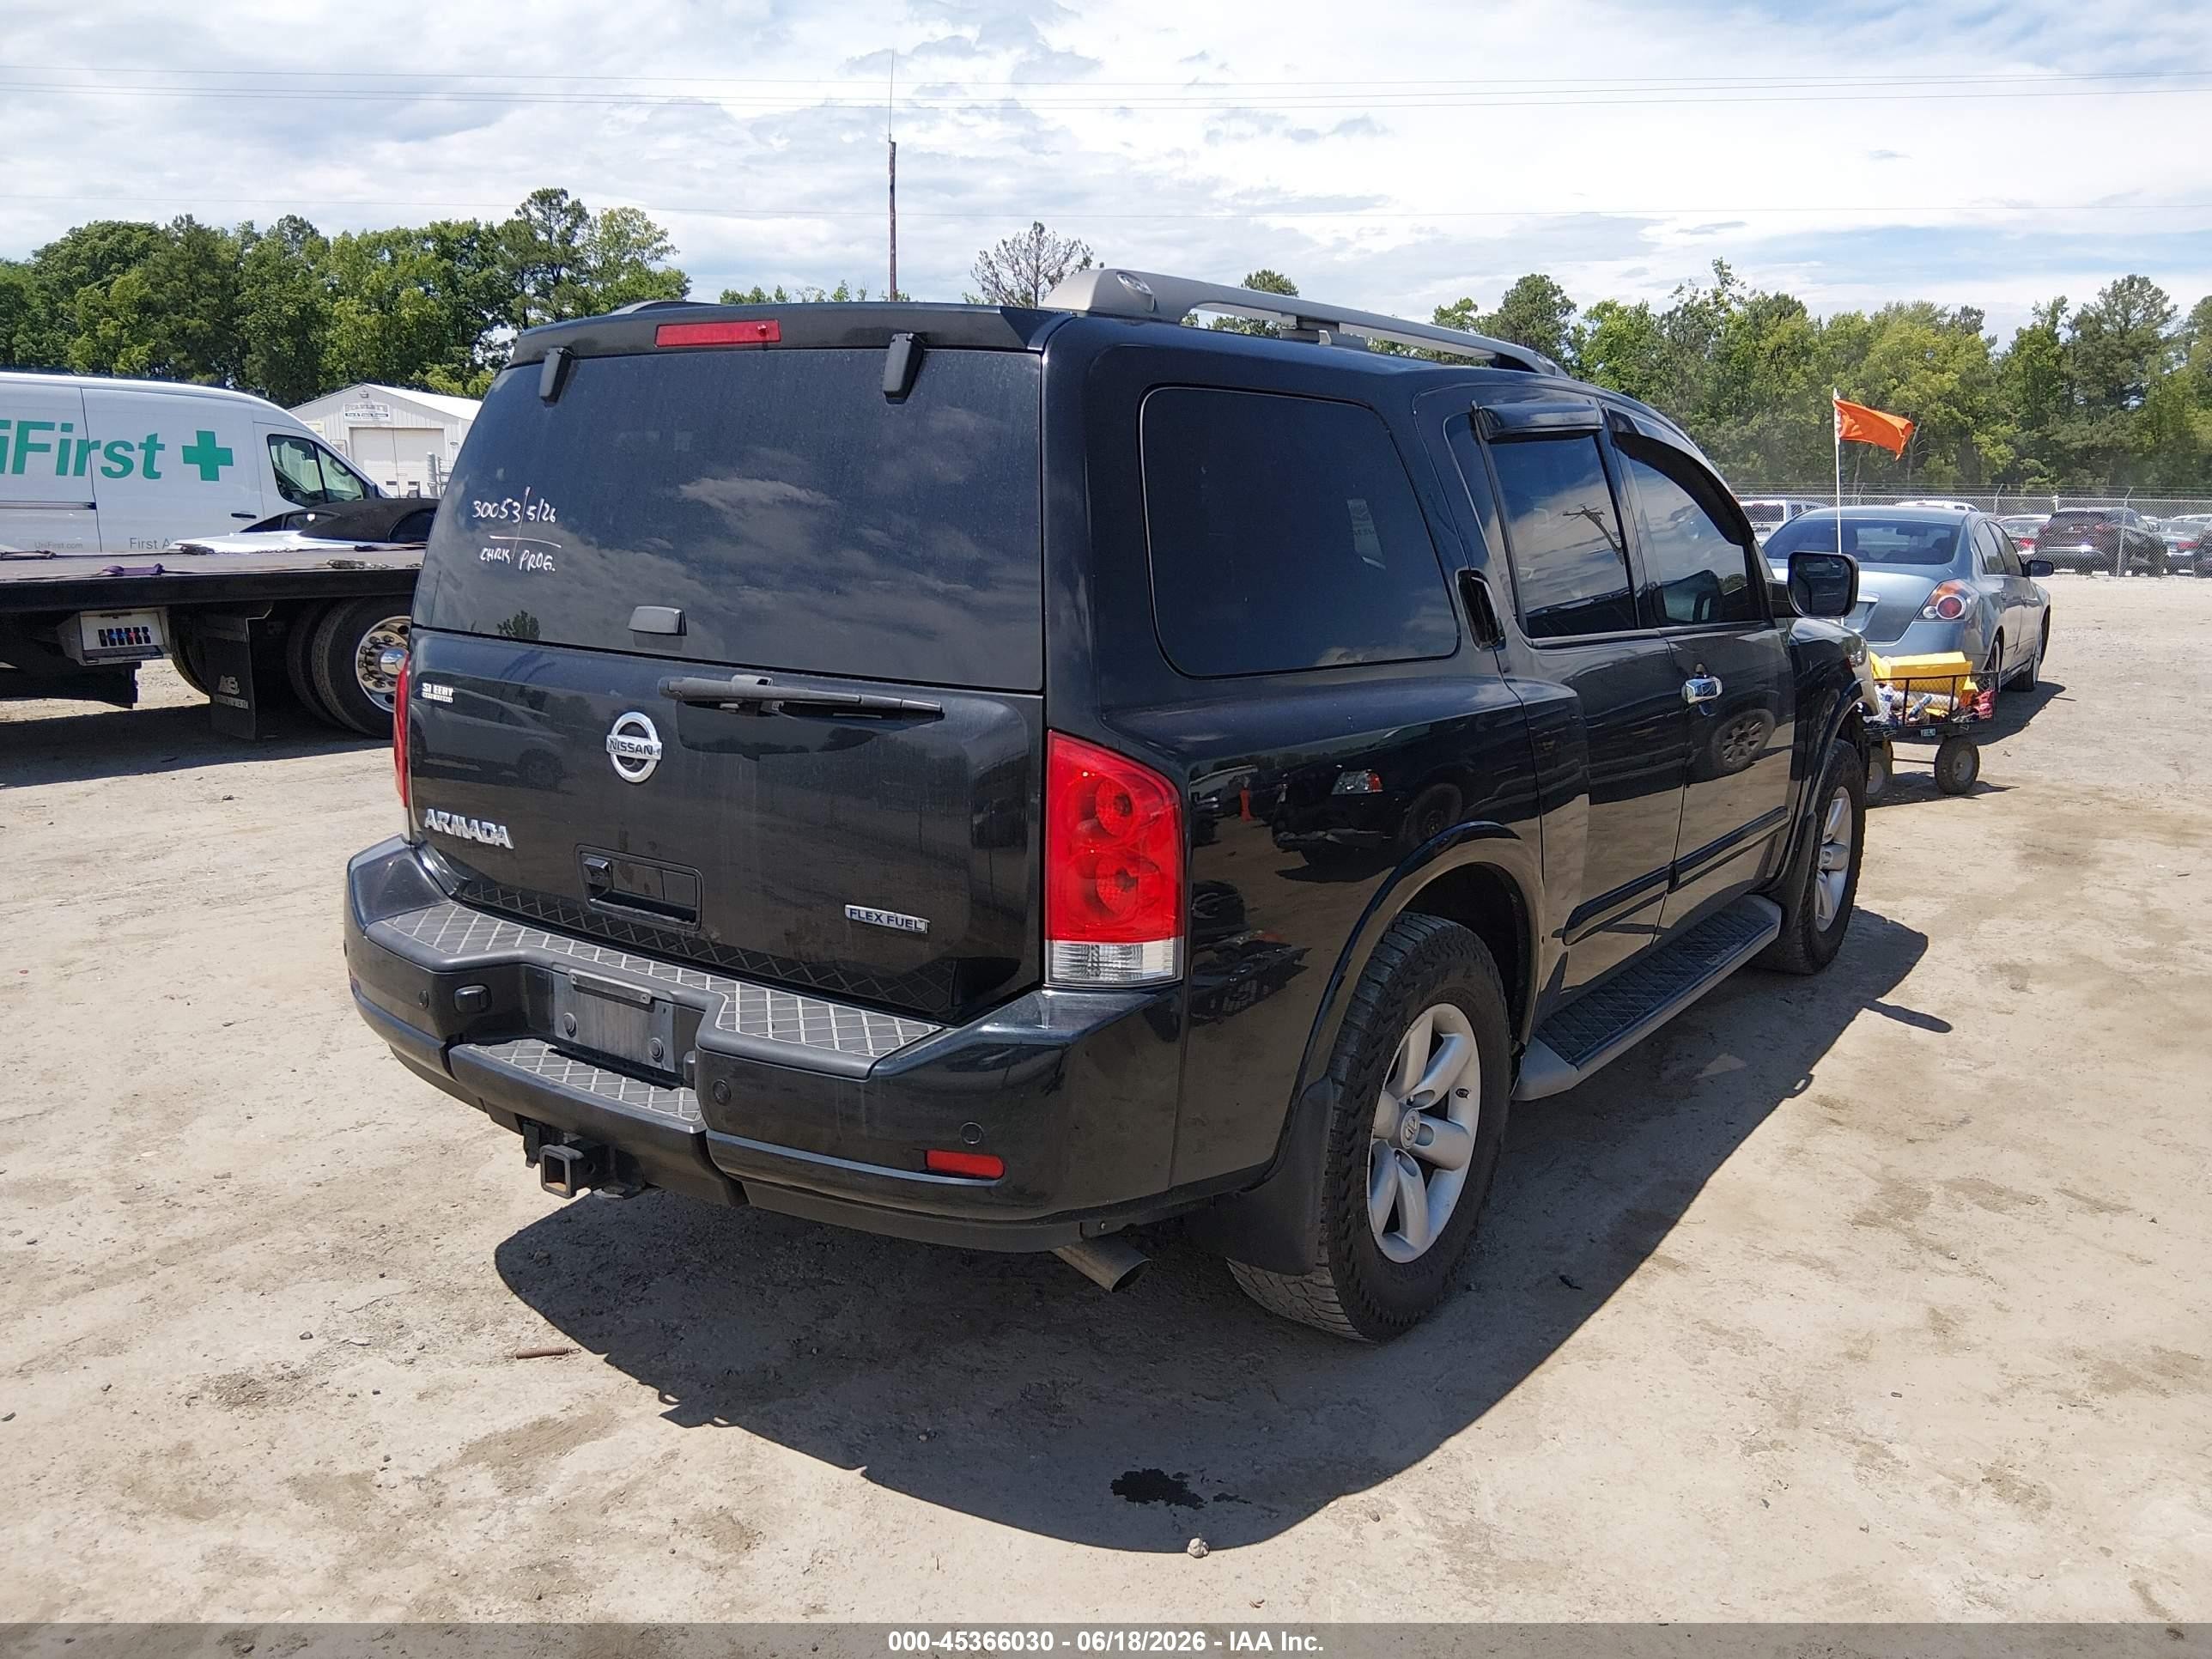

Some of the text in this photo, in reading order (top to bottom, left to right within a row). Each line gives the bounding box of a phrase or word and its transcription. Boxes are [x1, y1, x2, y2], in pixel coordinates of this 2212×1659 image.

[33, 541, 83, 550] UniFirst.com
[130, 538, 158, 550] First
[609, 738, 653, 756] NISSAN
[424, 808, 515, 849] ARMADA
[849, 908, 923, 930] FLEX FUEL
